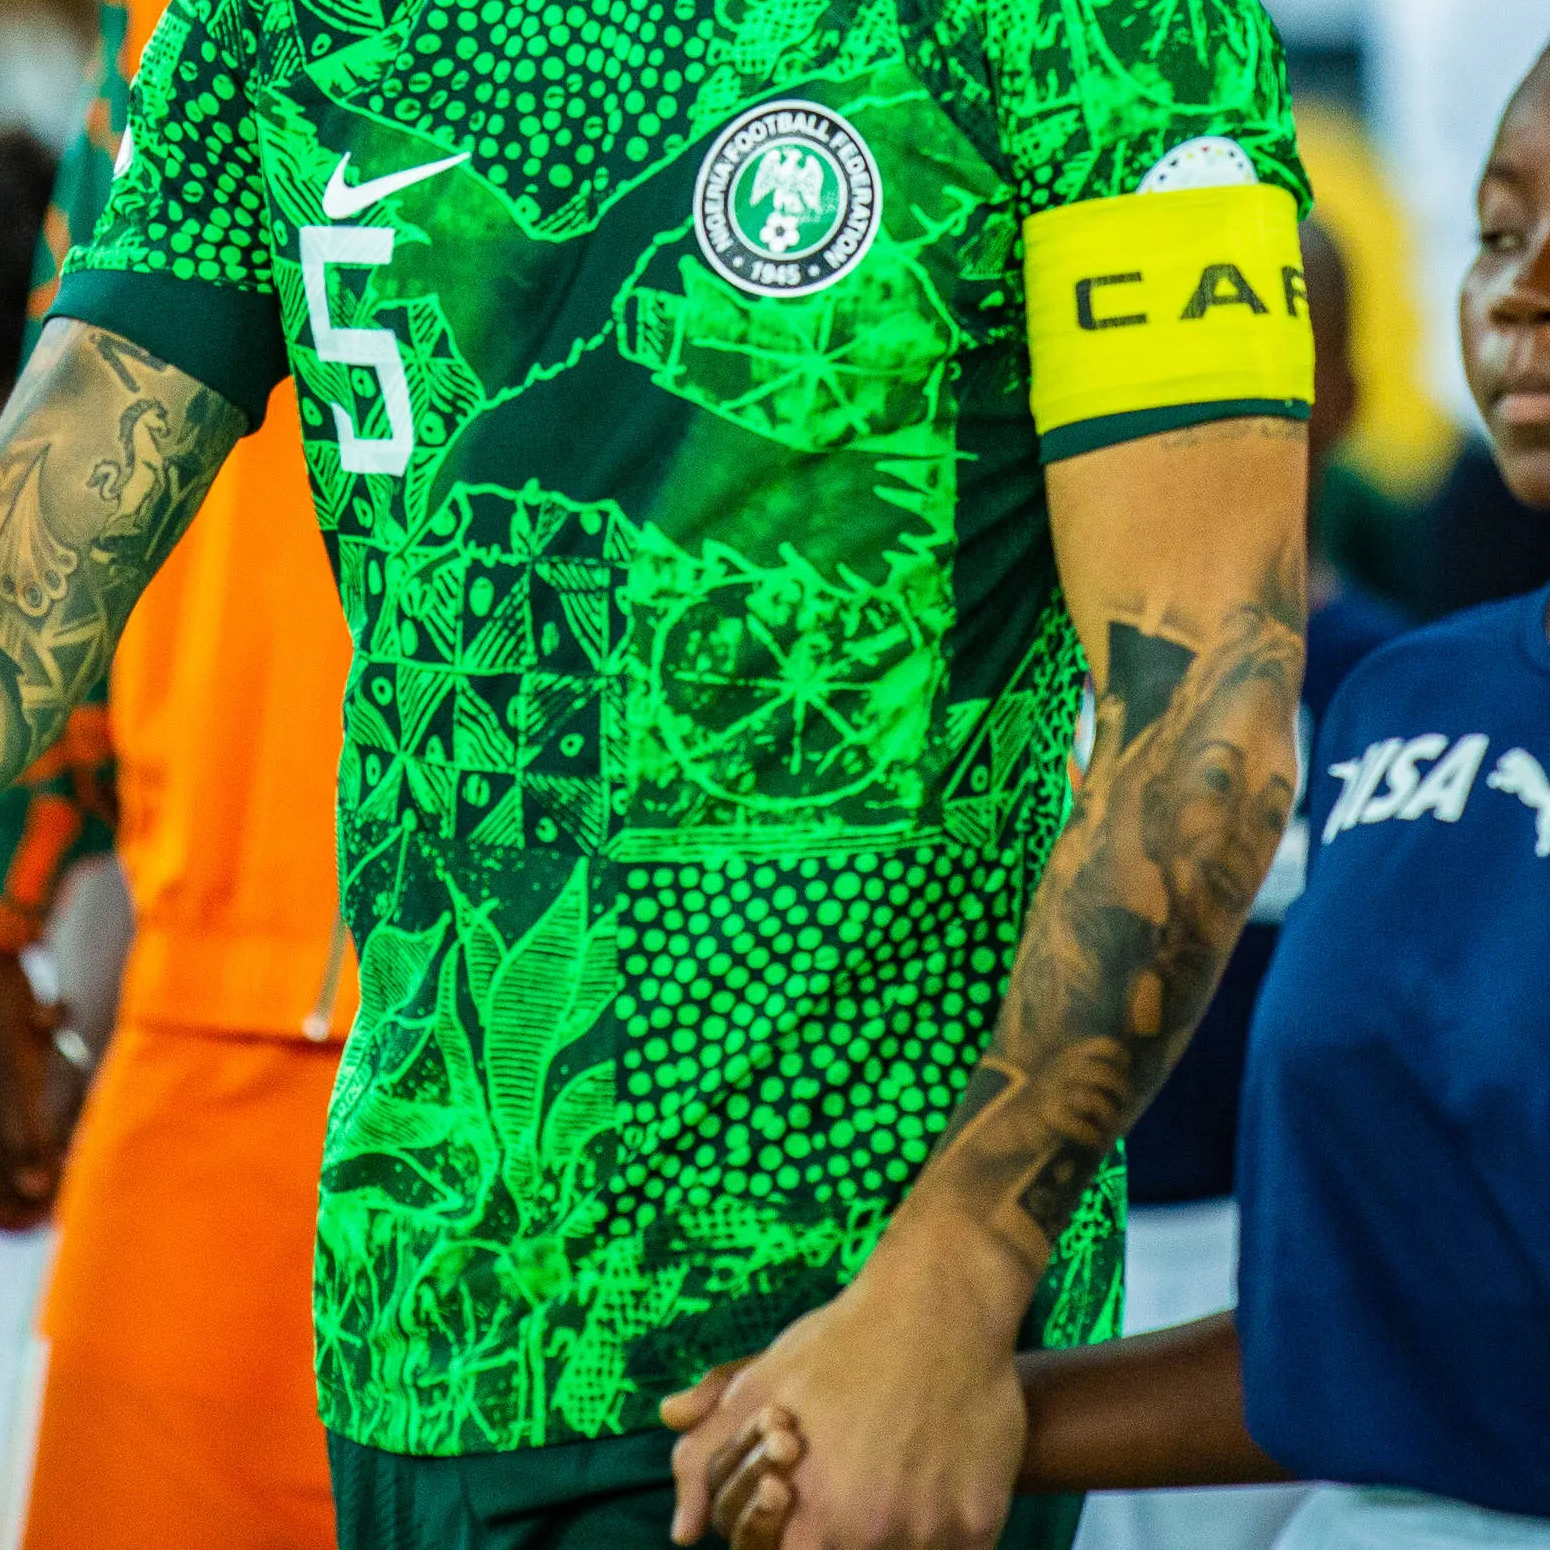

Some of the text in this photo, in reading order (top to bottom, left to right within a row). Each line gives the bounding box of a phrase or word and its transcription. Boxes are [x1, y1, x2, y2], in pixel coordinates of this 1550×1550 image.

[703, 111, 875, 270] NIGERIA FOOTBALL FEDERATION
[299, 226, 414, 478] 5
[1322, 733, 1490, 845] VISA
